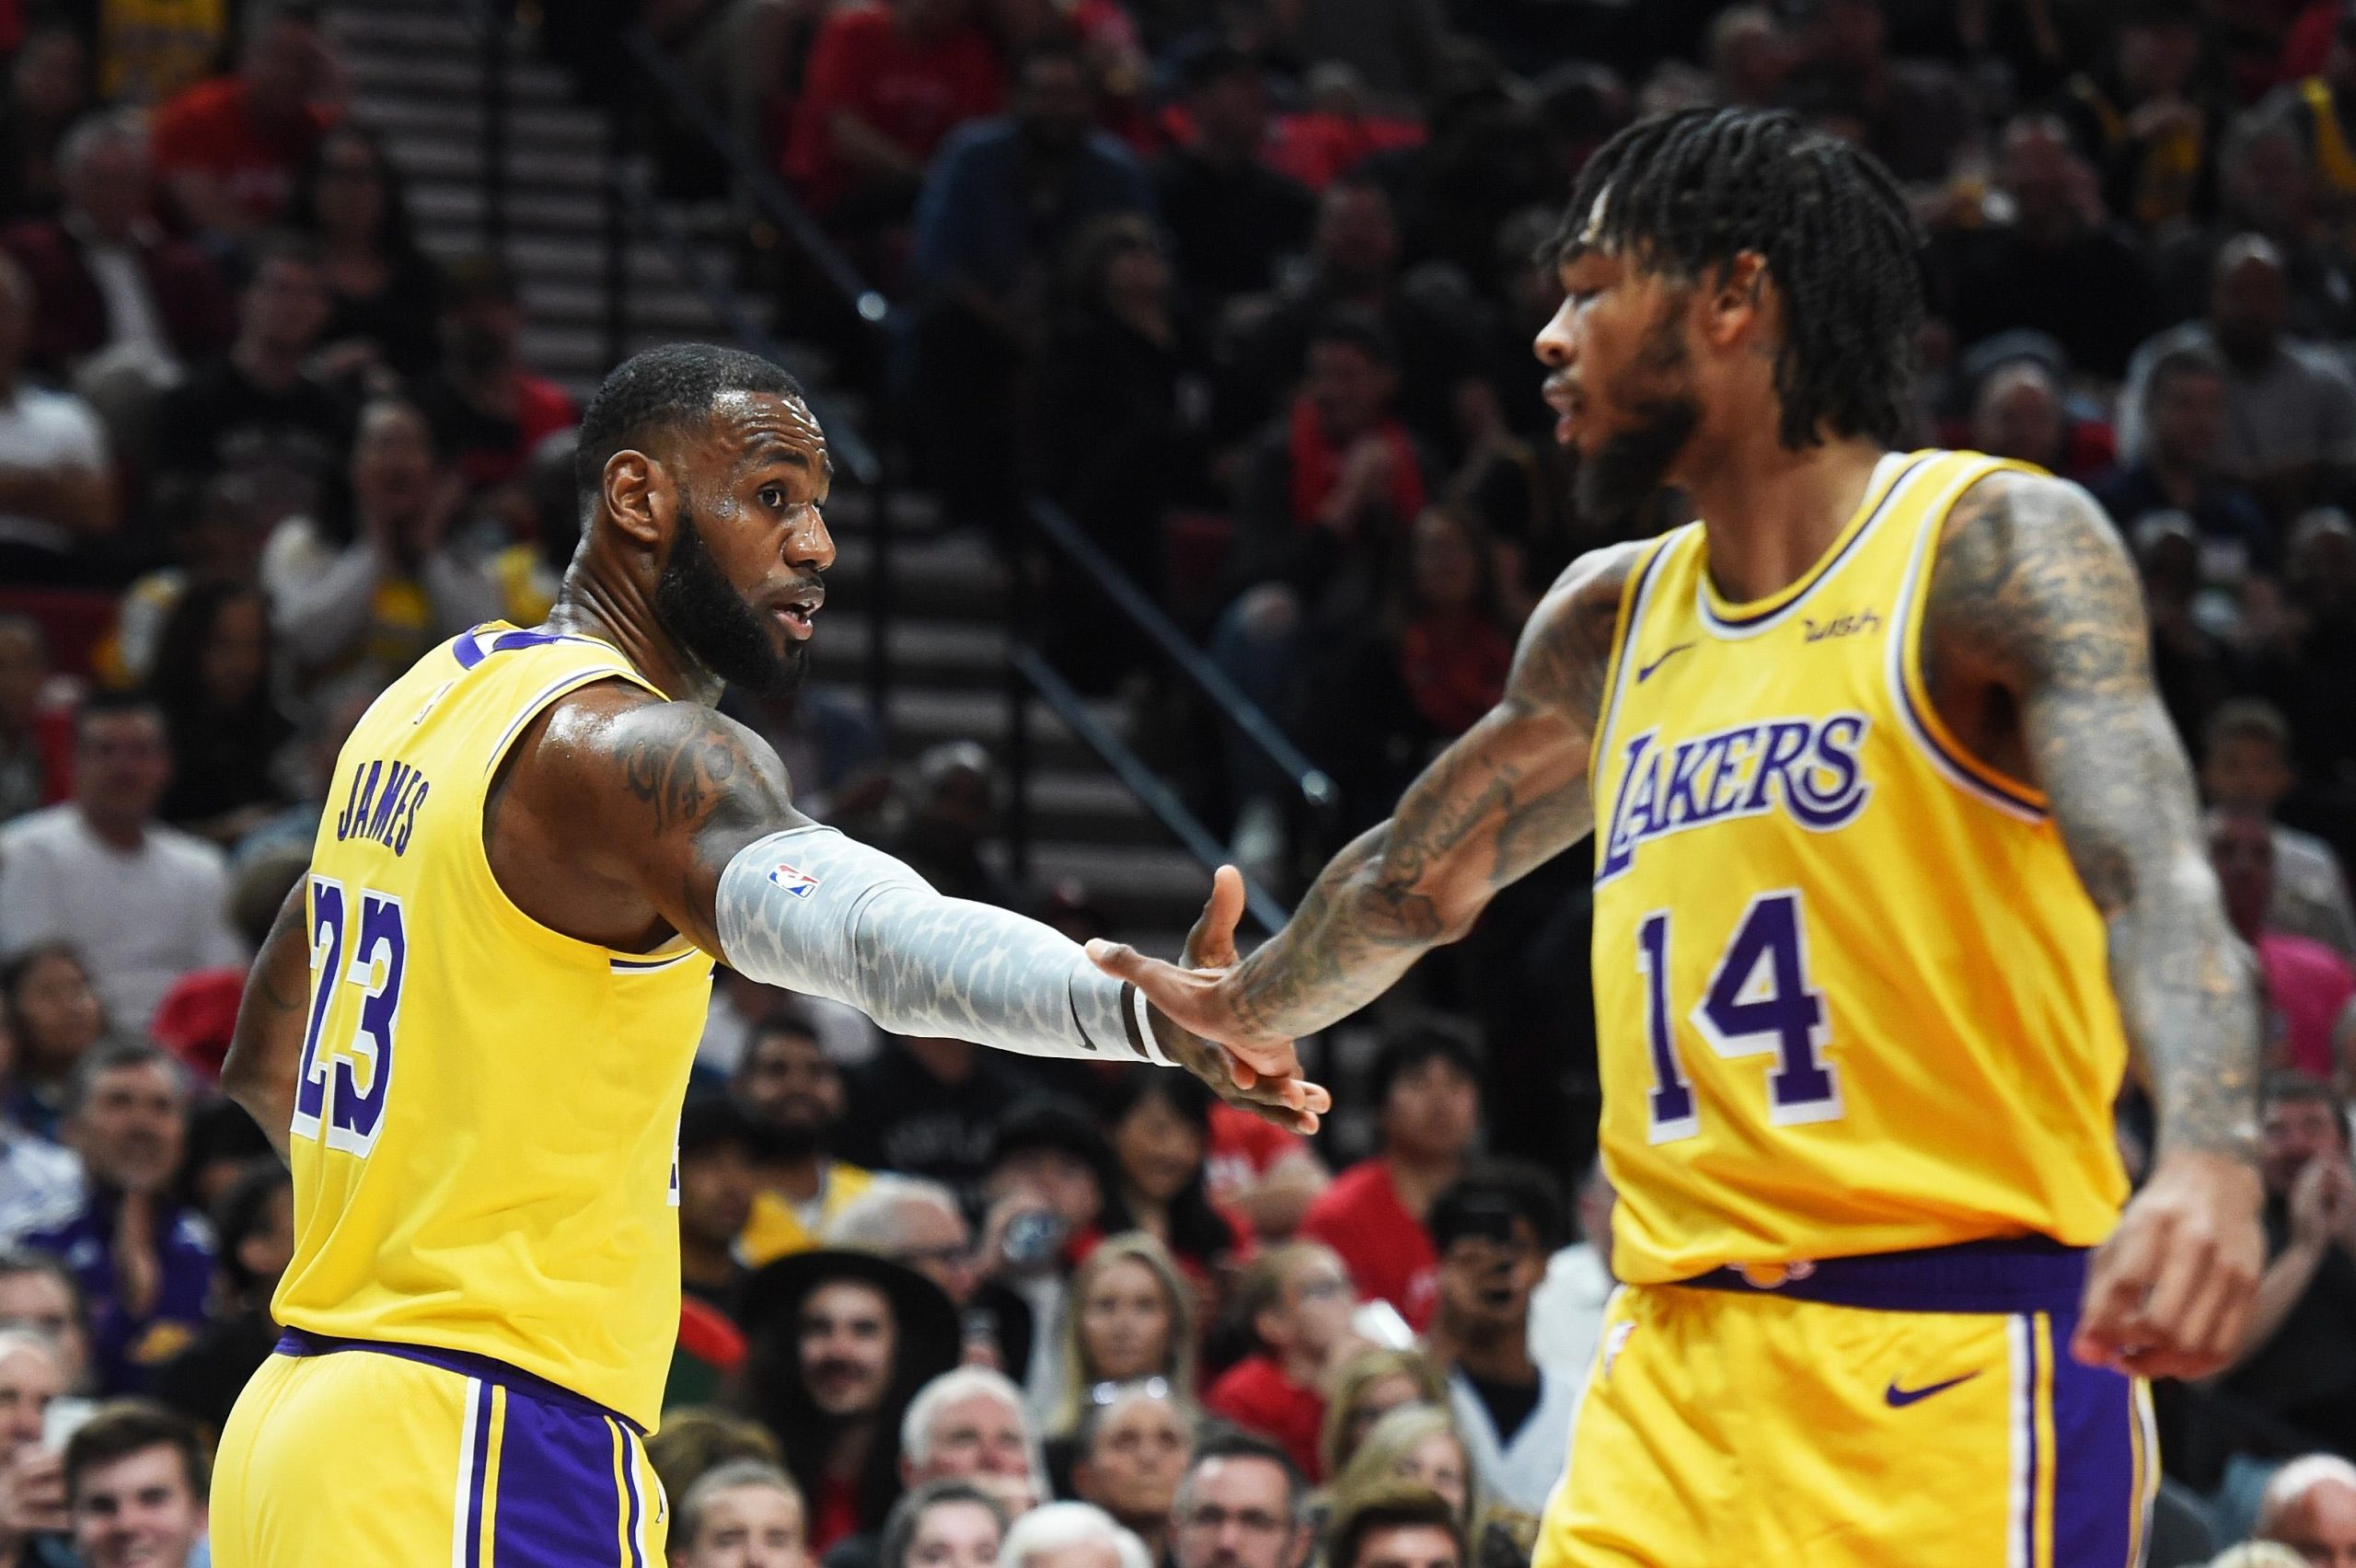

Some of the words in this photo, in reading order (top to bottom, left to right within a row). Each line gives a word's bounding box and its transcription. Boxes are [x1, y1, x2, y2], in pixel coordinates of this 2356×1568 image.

[337, 760, 429, 857] JAMES
[1594, 710, 1873, 888] LAKERS
[290, 874, 406, 1159] 23
[1635, 887, 1845, 1146] 14
